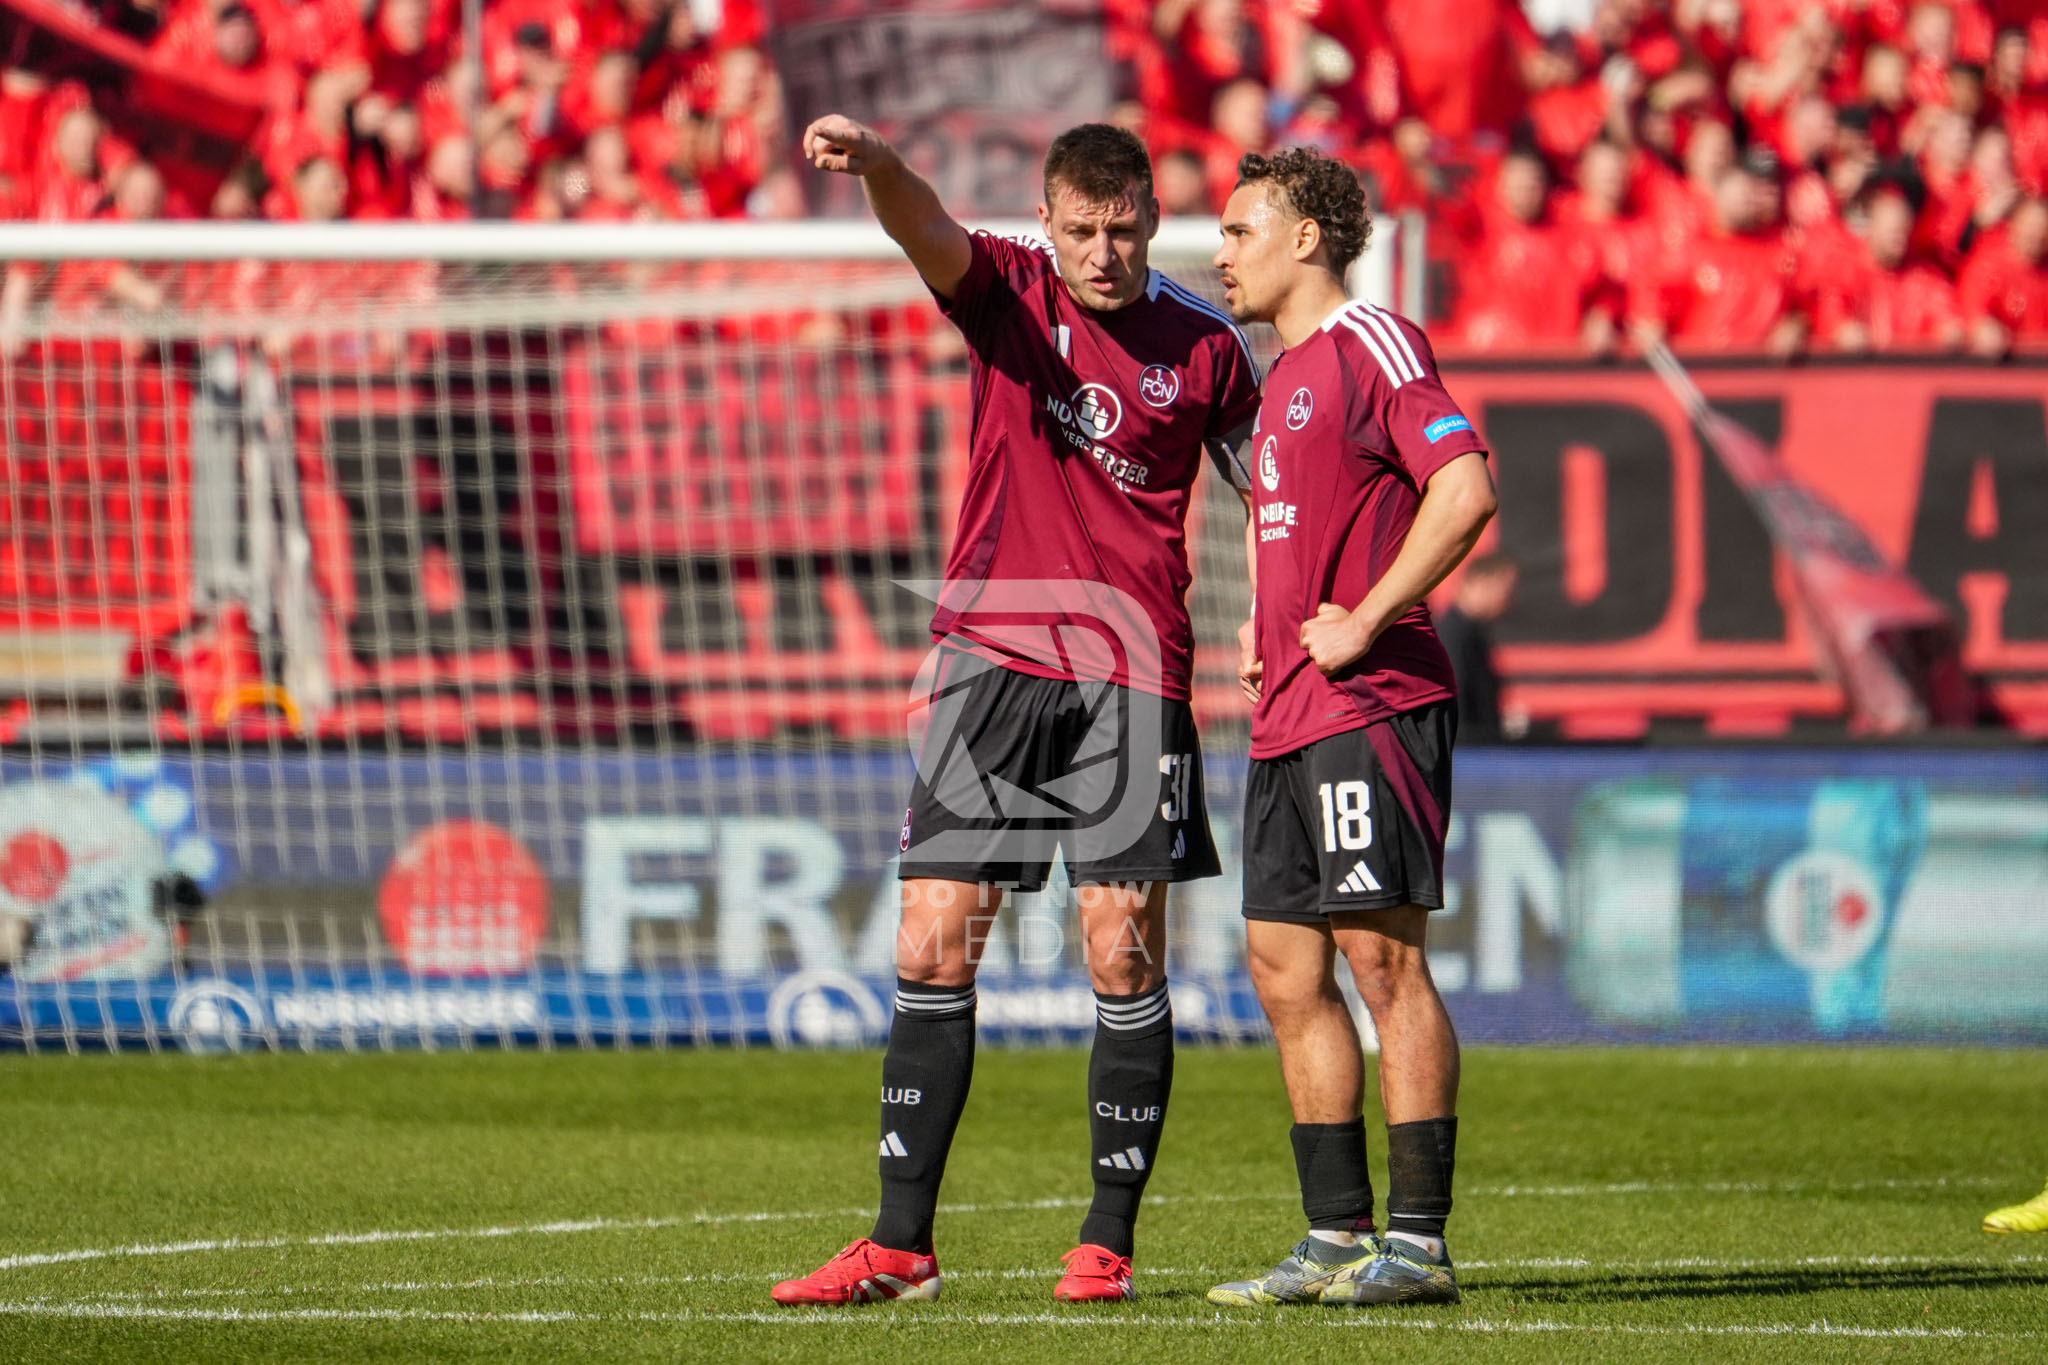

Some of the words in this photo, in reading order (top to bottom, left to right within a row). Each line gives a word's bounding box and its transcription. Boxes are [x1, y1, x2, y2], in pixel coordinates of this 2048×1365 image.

[1142, 377, 1173, 400] FCN
[1288, 405, 1309, 420] FCN
[1159, 753, 1192, 822] 31
[1318, 780, 1372, 852] 18
[1096, 1101, 1161, 1122] CLUB
